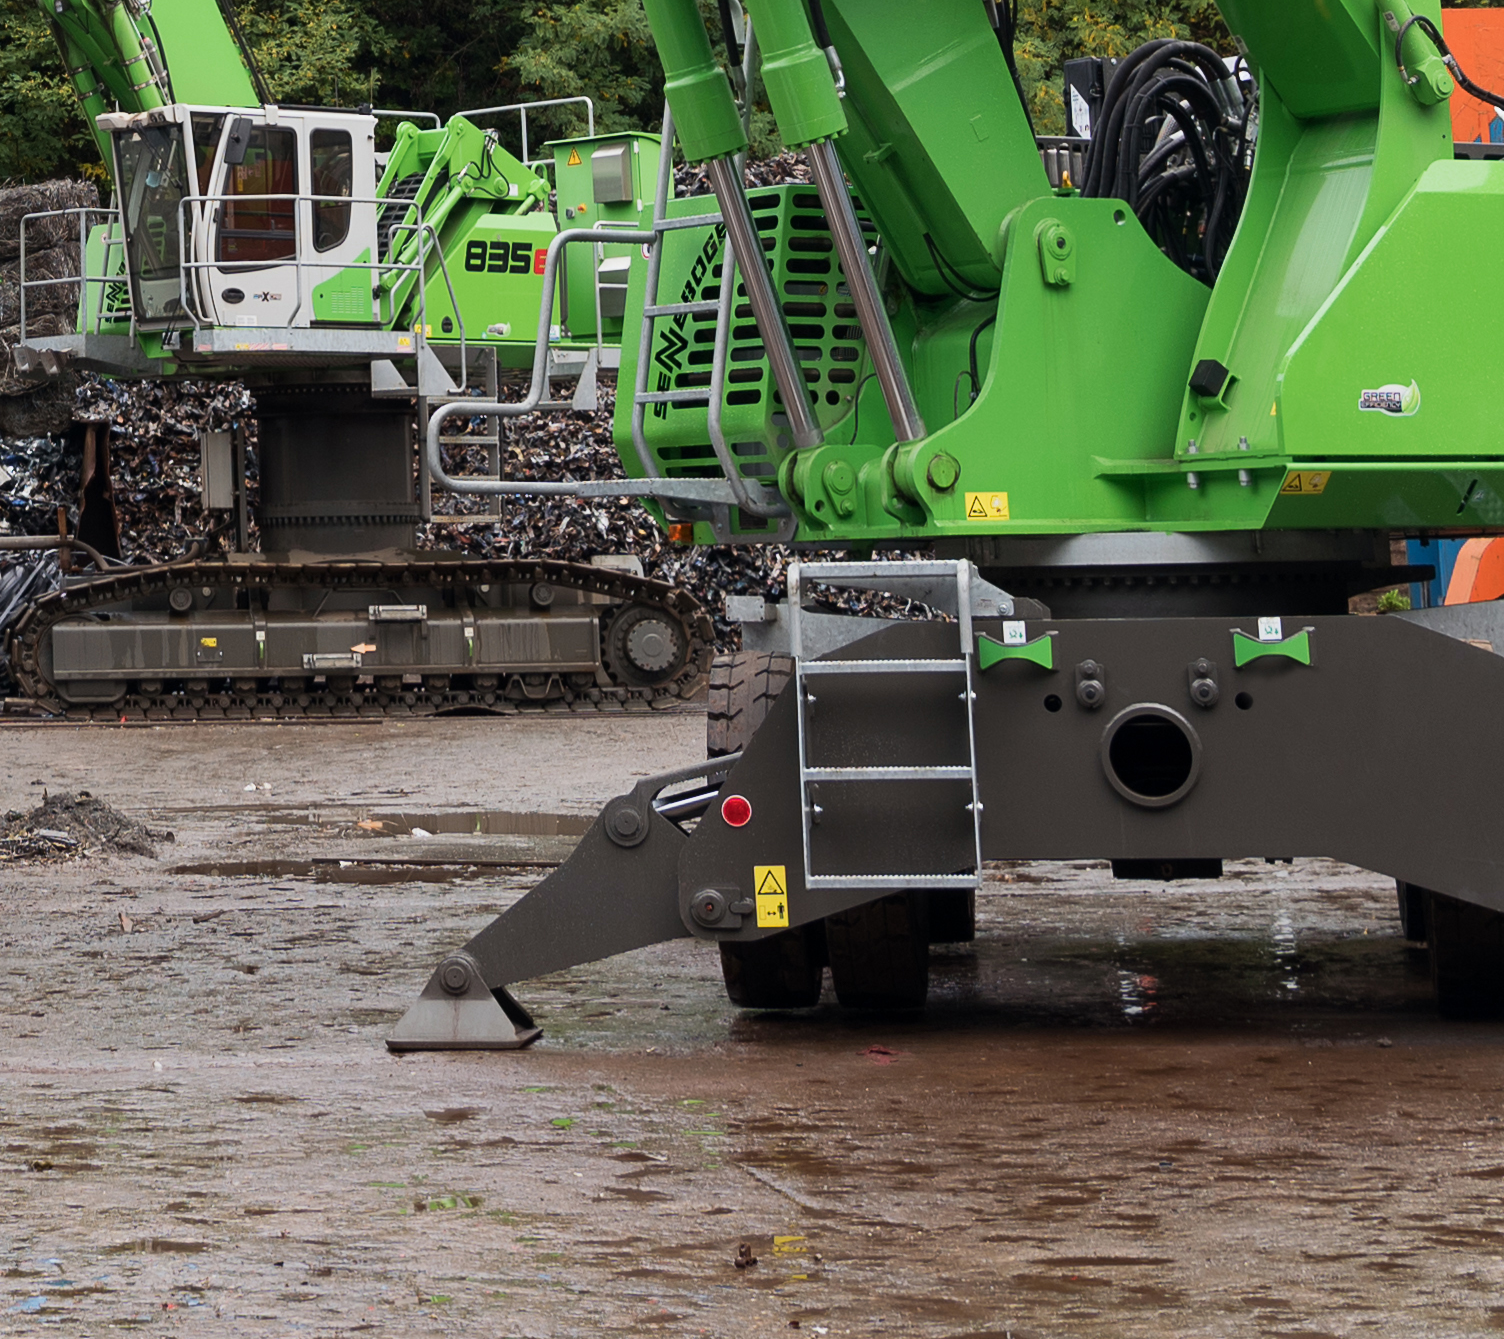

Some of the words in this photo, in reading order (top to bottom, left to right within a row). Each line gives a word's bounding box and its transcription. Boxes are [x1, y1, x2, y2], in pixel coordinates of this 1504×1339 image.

[465, 239, 547, 275] 835E
[653, 223, 728, 420] SENNEBOGE
[1363, 392, 1401, 401] GREEN
